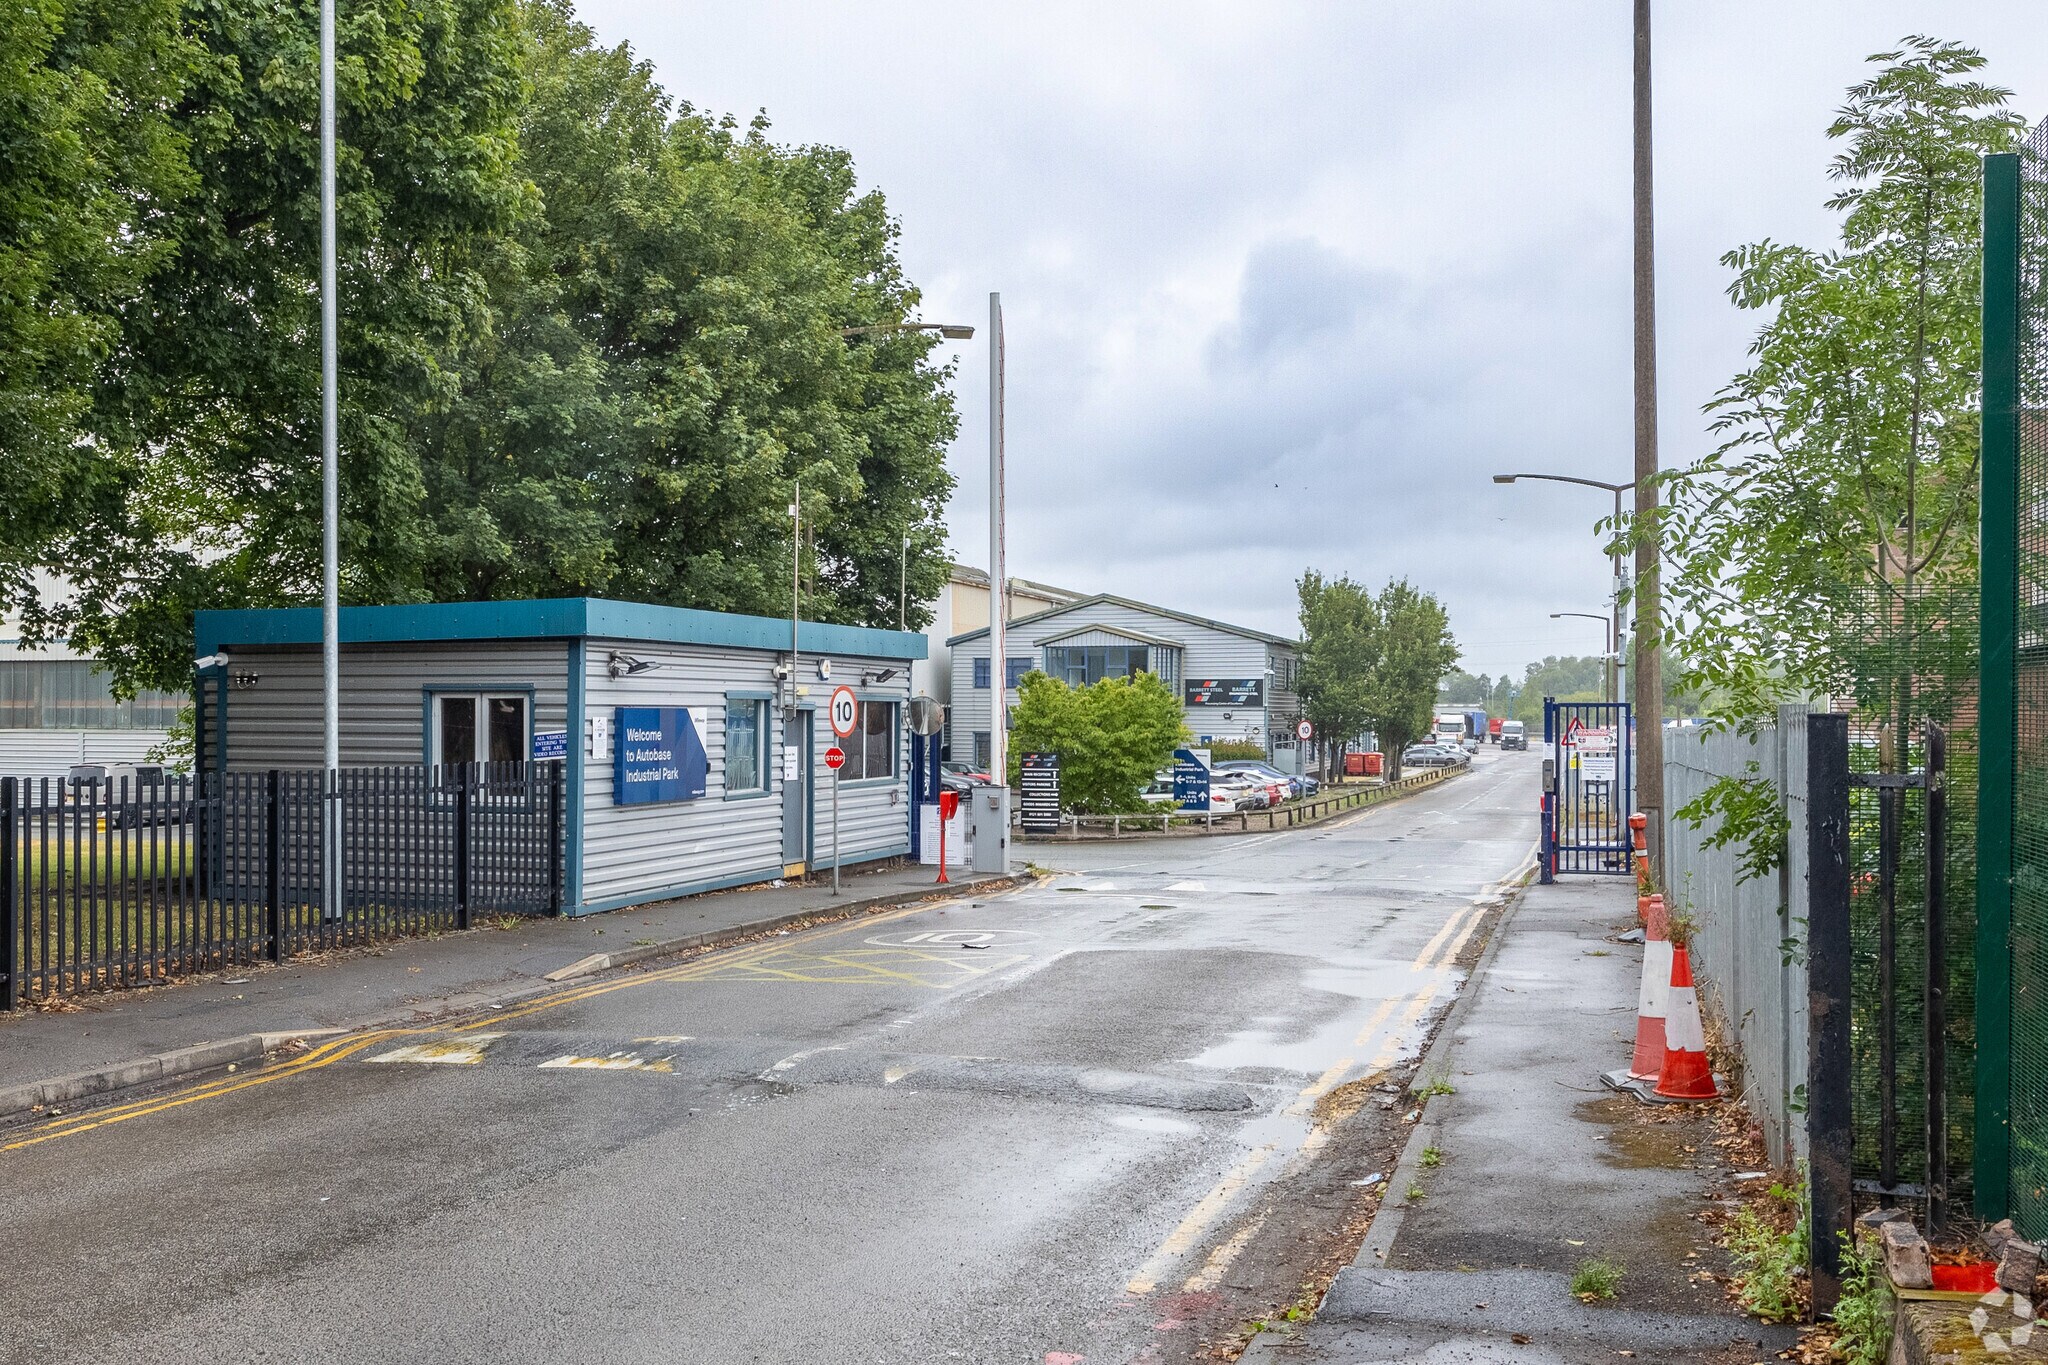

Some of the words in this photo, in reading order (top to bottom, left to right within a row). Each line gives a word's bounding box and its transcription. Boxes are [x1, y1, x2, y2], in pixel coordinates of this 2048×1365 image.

[836, 701, 852, 721] 10
[626, 728, 662, 742] Welcome
[1302, 726, 1310, 734] 10
[626, 750, 634, 762] to
[636, 748, 672, 762] Autobase
[626, 768, 662, 782] Industrial
[663, 767, 679, 780] Park
[902, 932, 996, 943] 10
